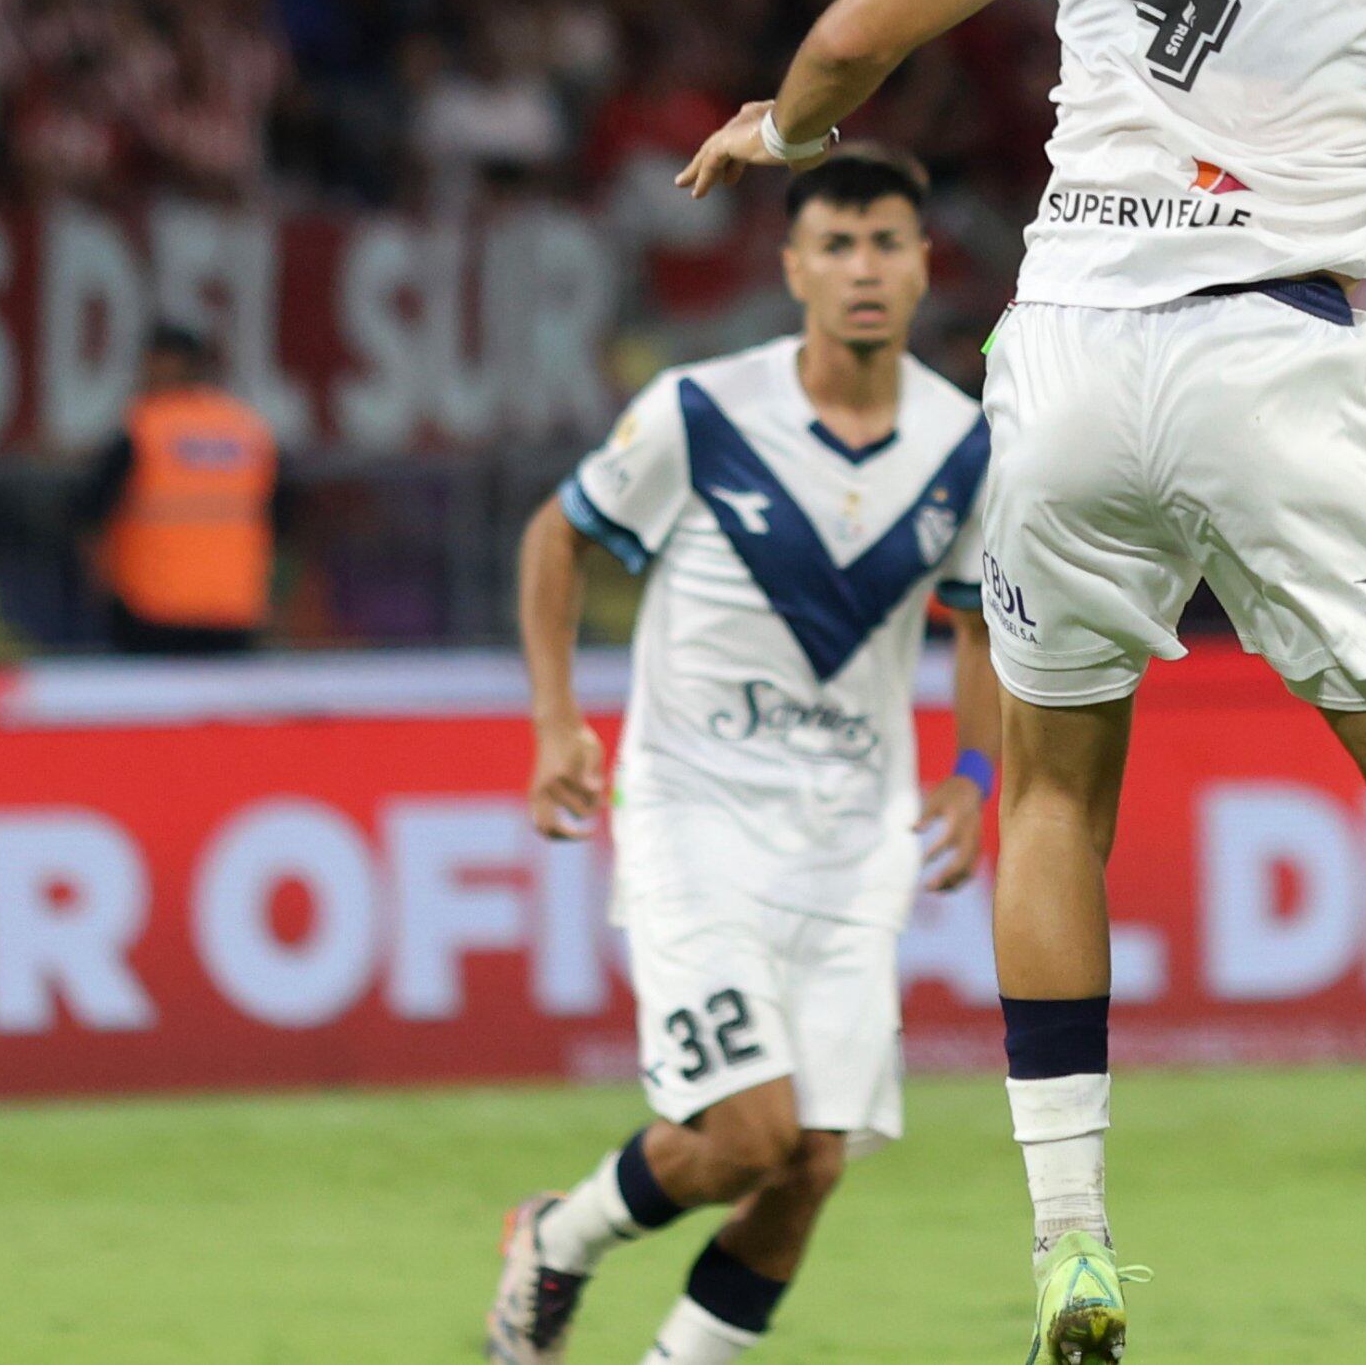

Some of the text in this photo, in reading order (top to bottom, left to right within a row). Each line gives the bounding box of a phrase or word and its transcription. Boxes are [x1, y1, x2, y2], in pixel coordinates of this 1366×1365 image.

[1165, 22, 1190, 58] RUS
[1048, 192, 1251, 228] SUPERVIELLE
[337, 214, 615, 449] SUR
[665, 987, 764, 1083] 32
